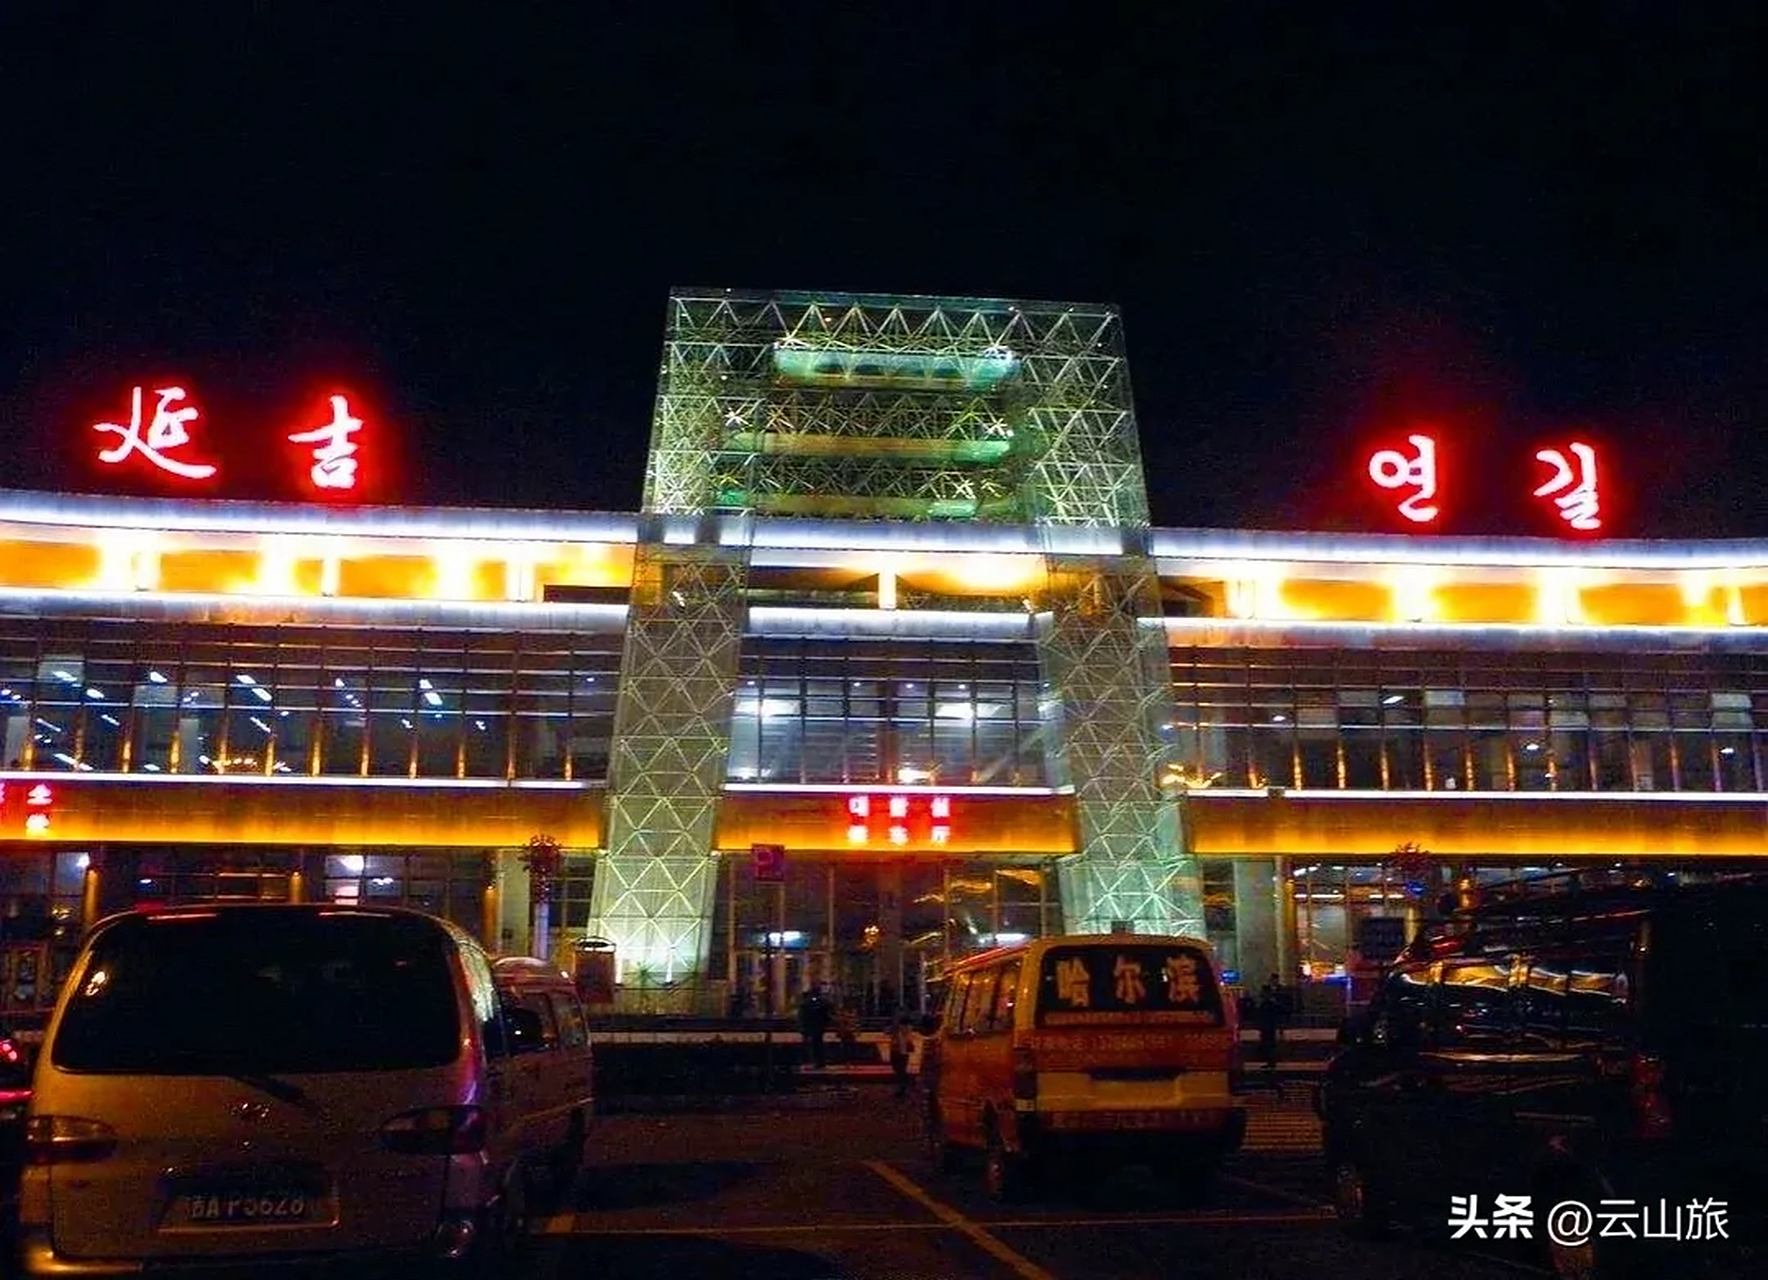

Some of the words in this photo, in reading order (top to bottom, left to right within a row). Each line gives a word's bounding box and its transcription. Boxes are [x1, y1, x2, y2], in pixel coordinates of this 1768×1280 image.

[94, 386, 364, 489] 延吉
[1369, 434, 1602, 530] 연길
[1057, 955, 1200, 1007] 哈尔滨
